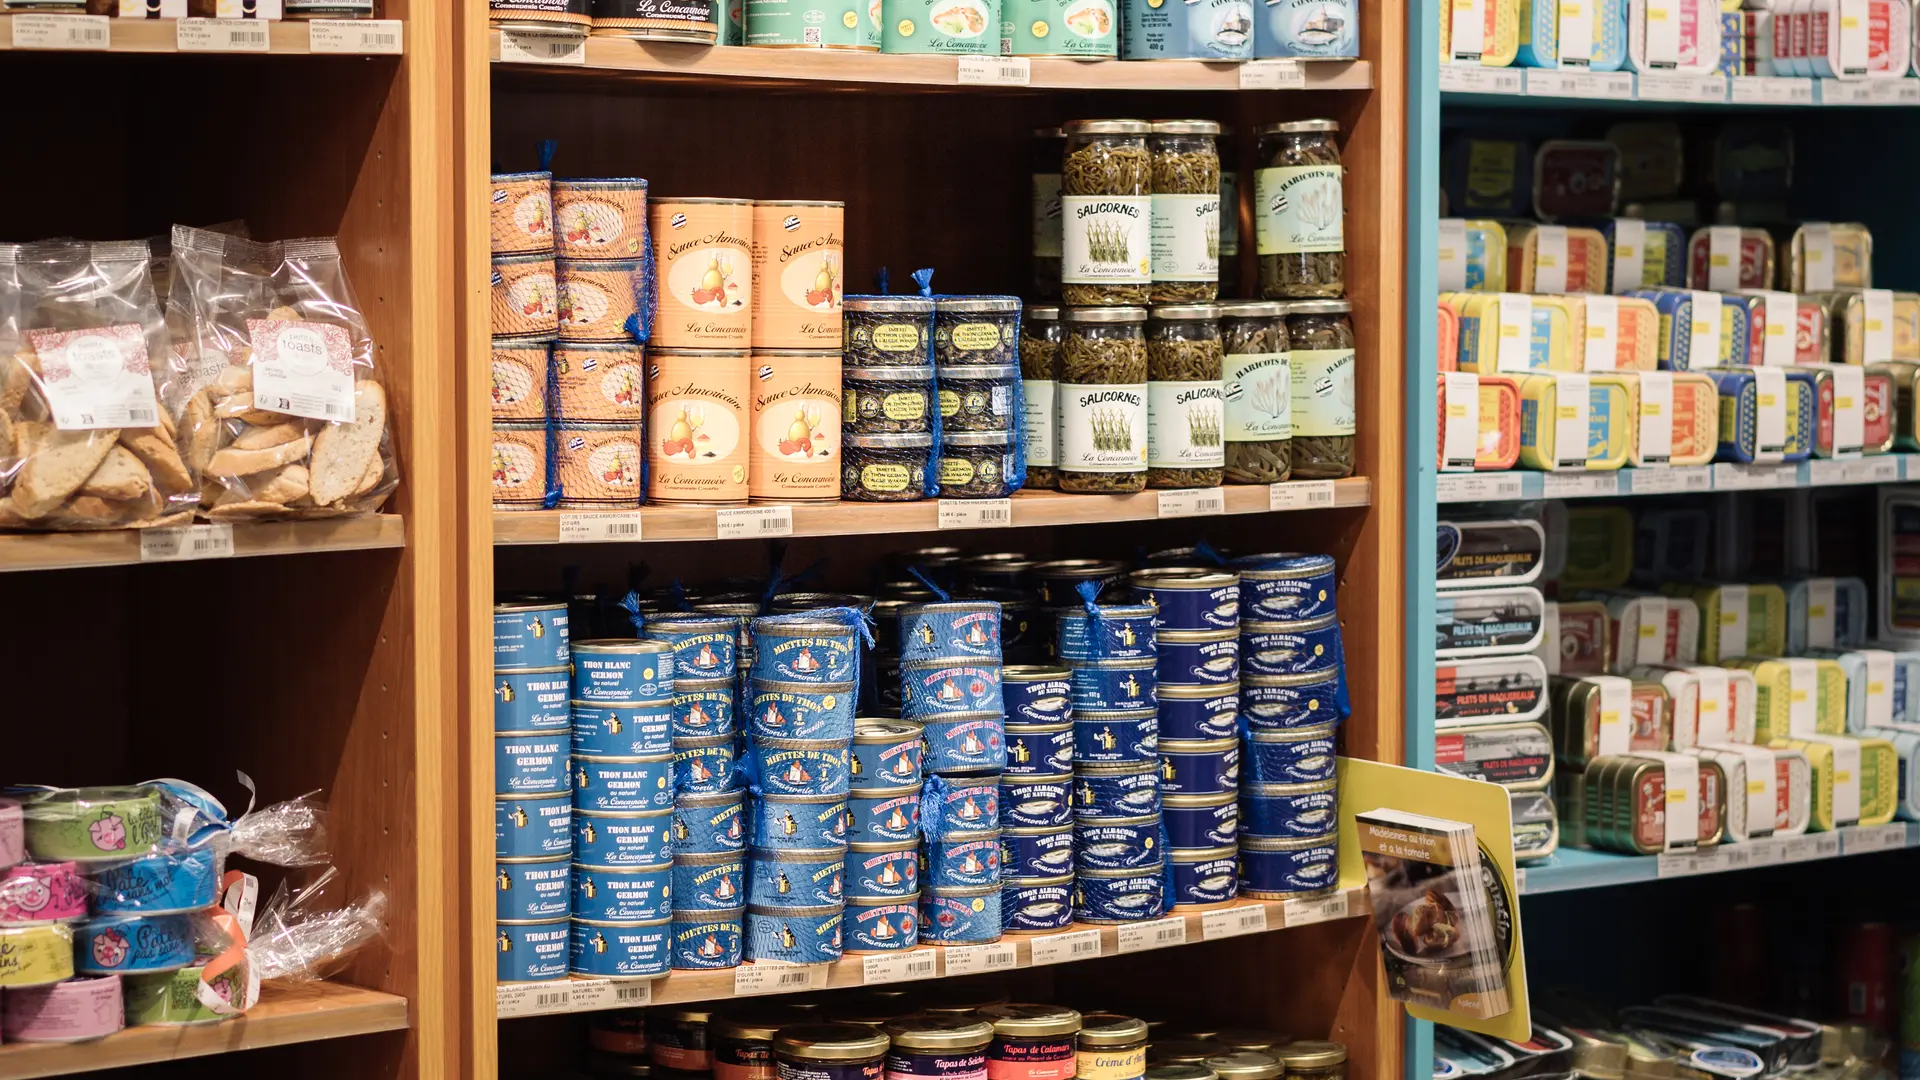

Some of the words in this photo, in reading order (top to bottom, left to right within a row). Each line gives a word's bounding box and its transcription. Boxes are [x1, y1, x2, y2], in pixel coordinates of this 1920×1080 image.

[636, 1, 657, 12] La
[659, 1, 710, 16] Concarnoise
[1280, 171, 1325, 192] HARICOTS
[1077, 202, 1140, 219] SALICORNES
[667, 238, 702, 261] Sauce
[779, 241, 813, 263] Sauce
[685, 322, 701, 334] La
[281, 338, 323, 355] toasts
[1235, 358, 1279, 379] HARICOTS
[671, 382, 743, 412] Armoricaine
[754, 390, 788, 412] Sauce
[1080, 391, 1141, 407] SALICORNES
[658, 473, 670, 484] La
[674, 473, 726, 485] Concarnoise
[773, 472, 788, 483] La
[1453, 556, 1474, 566] FILETS
[1475, 555, 1484, 564] DE
[1256, 582, 1276, 592] THON
[1277, 580, 1312, 589] ALBACORE
[1453, 625, 1474, 636] FILETS
[673, 634, 713, 653] MIETTES
[1250, 636, 1270, 645] THON
[1271, 634, 1306, 644] ALBACORE
[773, 638, 813, 656] MIETTES
[815, 638, 828, 646] DE
[583, 660, 603, 669] THON
[605, 661, 631, 669] BLANC
[590, 671, 623, 679] GERMON
[781, 694, 794, 703] DE
[797, 697, 823, 713] THON
[1457, 695, 1477, 705] FILETS
[1478, 694, 1488, 703] DE
[505, 745, 533, 754] THON
[533, 744, 559, 753] BLANC
[516, 756, 553, 766] GERMON
[766, 750, 807, 767] MIETTES
[809, 750, 820, 759] DE
[598, 771, 620, 779] THON
[1011, 787, 1033, 796] THON
[1033, 785, 1064, 796] ALBACORE
[1369, 825, 1408, 842] Madeleines
[1419, 836, 1436, 846] thon
[1395, 845, 1403, 854] la
[1404, 846, 1430, 859] tomate
[856, 905, 897, 923] MIETTES
[618, 936, 640, 944] THON
[641, 933, 663, 942] BLANC
[678, 923, 719, 942] MIETTES
[720, 923, 730, 932] DE
[627, 944, 657, 953] GERMON
[736, 1050, 757, 1059] Tapas
[1003, 1045, 1027, 1054] Tapas
[1029, 1045, 1039, 1054] de
[1040, 1044, 1070, 1054] Calamars
[934, 1059, 958, 1070] Tapas
[959, 1058, 967, 1067] de
[1096, 1057, 1123, 1067] Crème
[862, 1066, 879, 1076] Tapas
